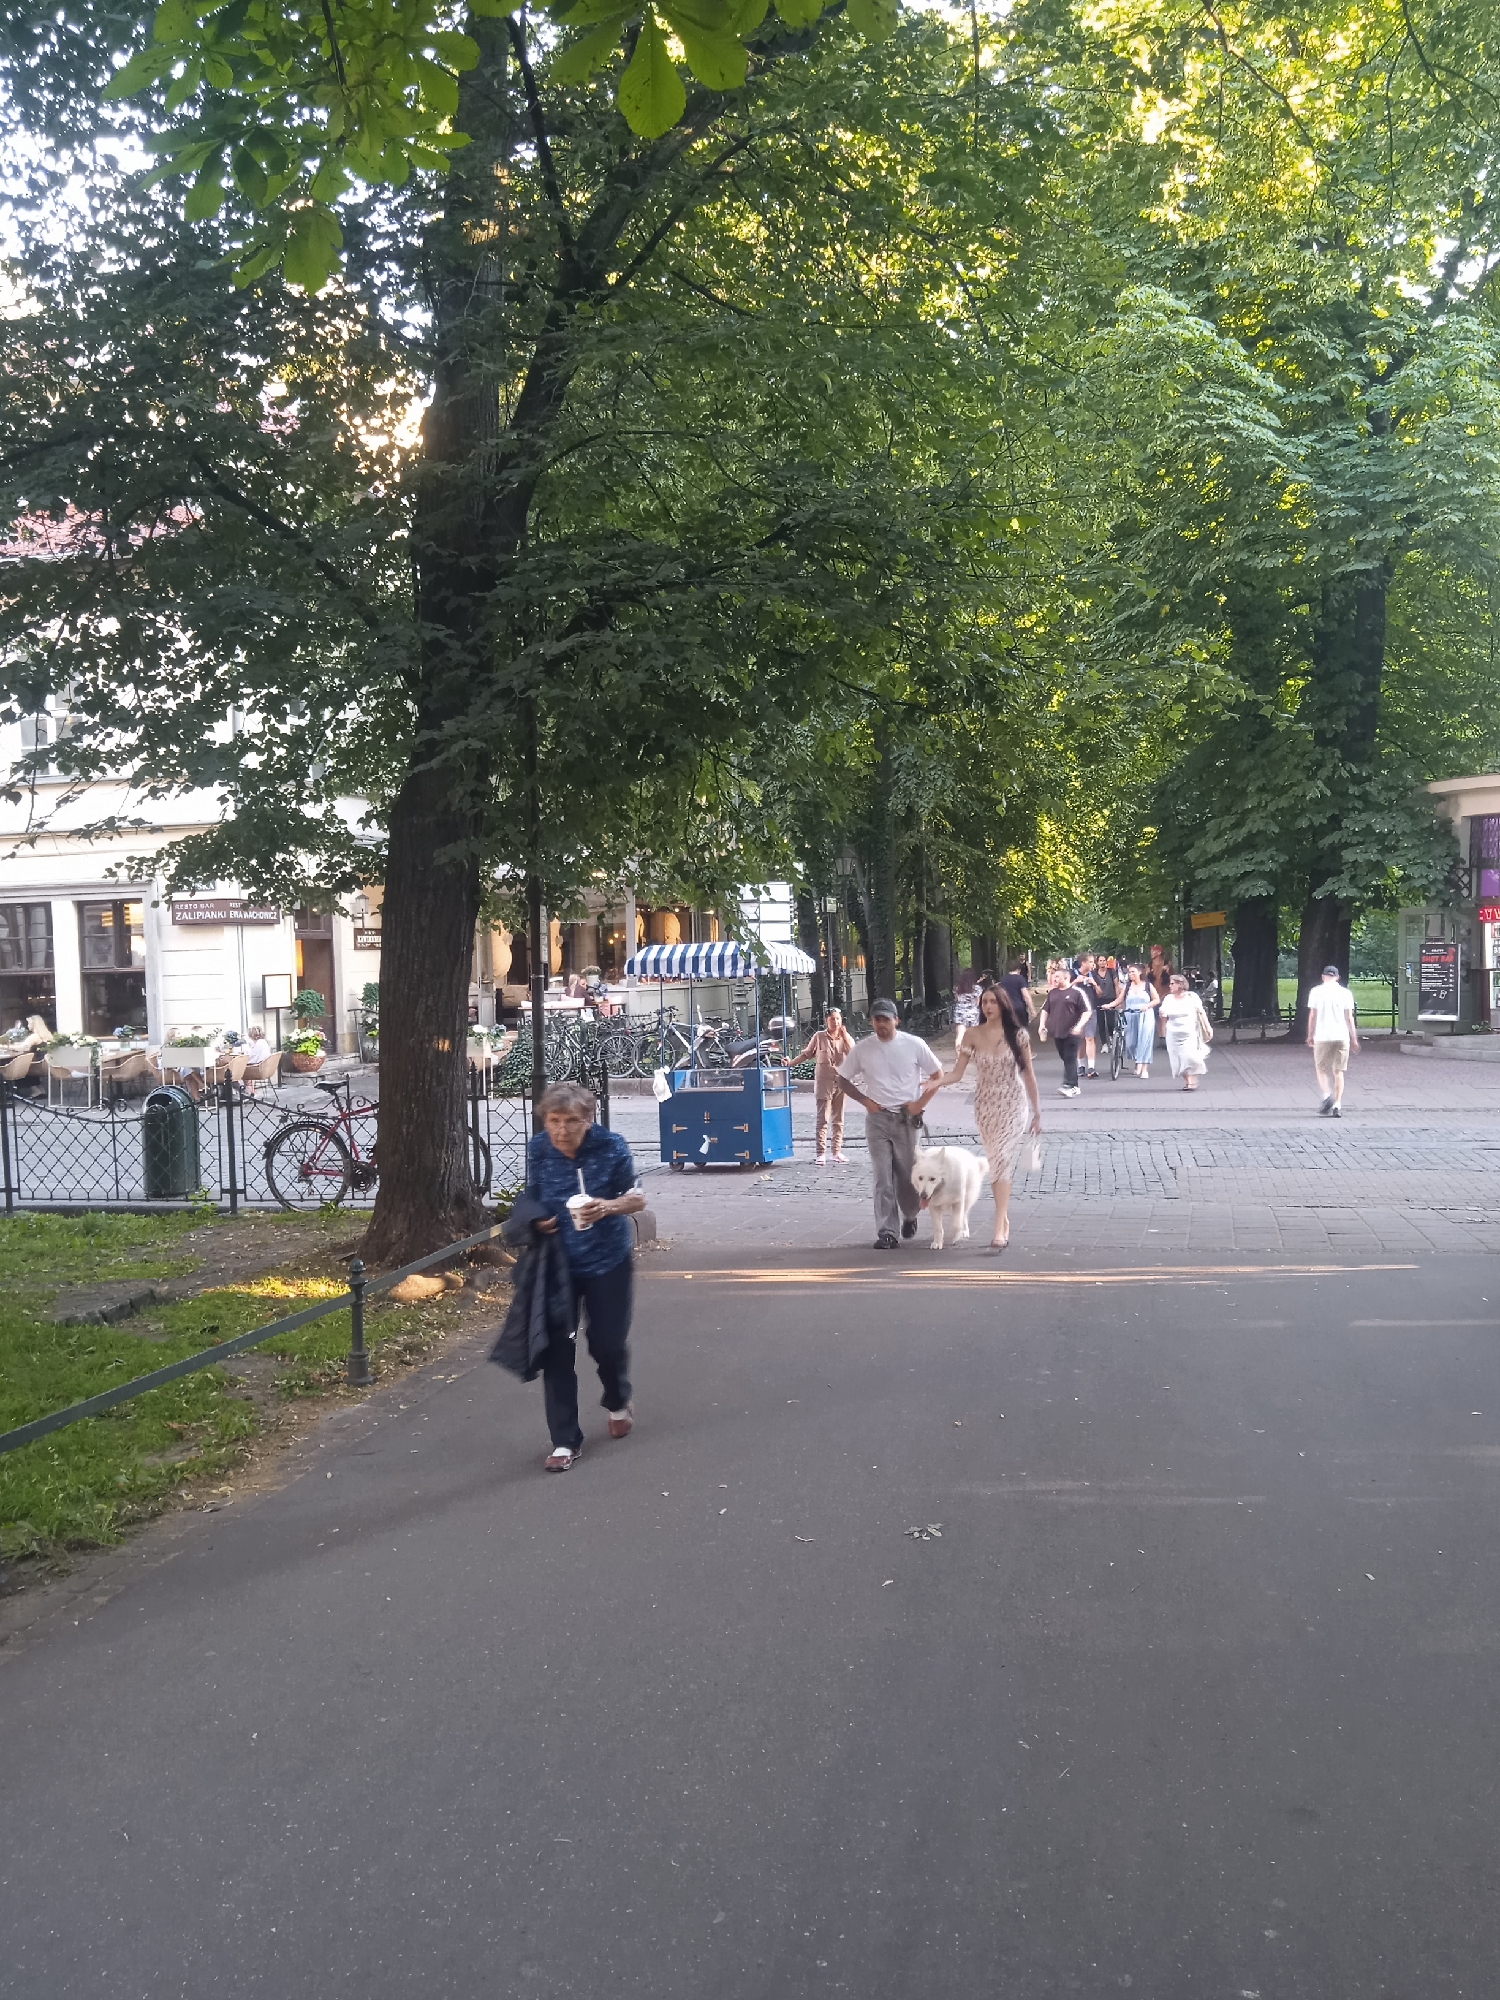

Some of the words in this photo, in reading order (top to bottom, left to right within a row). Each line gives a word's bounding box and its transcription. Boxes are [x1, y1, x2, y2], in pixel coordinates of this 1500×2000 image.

[175, 911, 227, 920] ZALIPIANKI
[229, 910, 243, 919] EWA
[243, 911, 277, 920] WACHOWICZ
